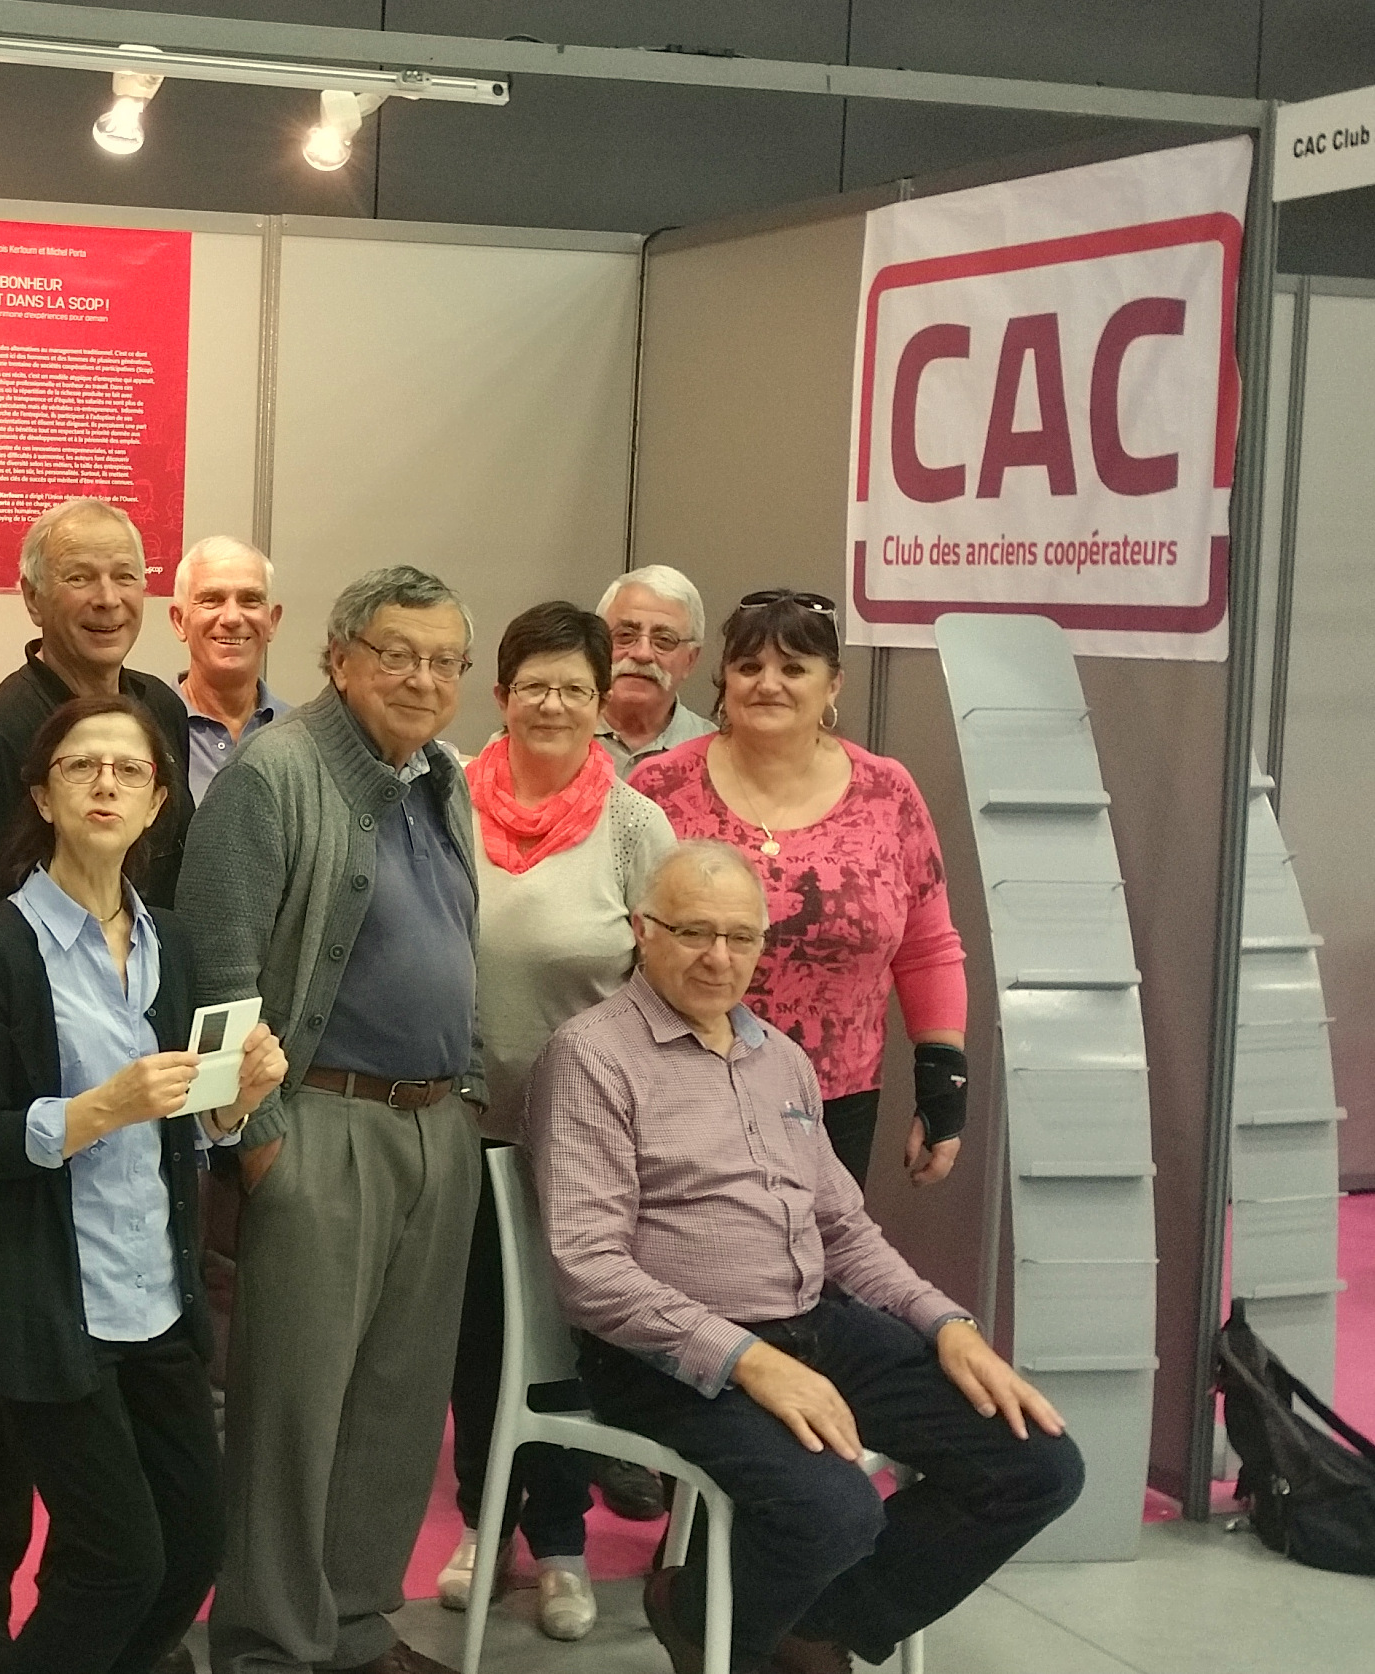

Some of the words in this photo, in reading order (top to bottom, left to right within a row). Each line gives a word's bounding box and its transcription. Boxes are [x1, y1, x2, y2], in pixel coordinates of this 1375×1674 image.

[1293, 132, 1327, 158] CAC
[1332, 124, 1371, 151] Club
[38, 246, 46, 255] et
[0, 275, 63, 292] BONHEUR
[6, 292, 44, 309] DANS
[46, 295, 66, 309] LA
[890, 296, 1187, 504] CAC
[882, 535, 924, 566] Club
[929, 534, 961, 566] des
[965, 533, 1038, 566] anciens
[1044, 528, 1178, 575] coopérateurs
